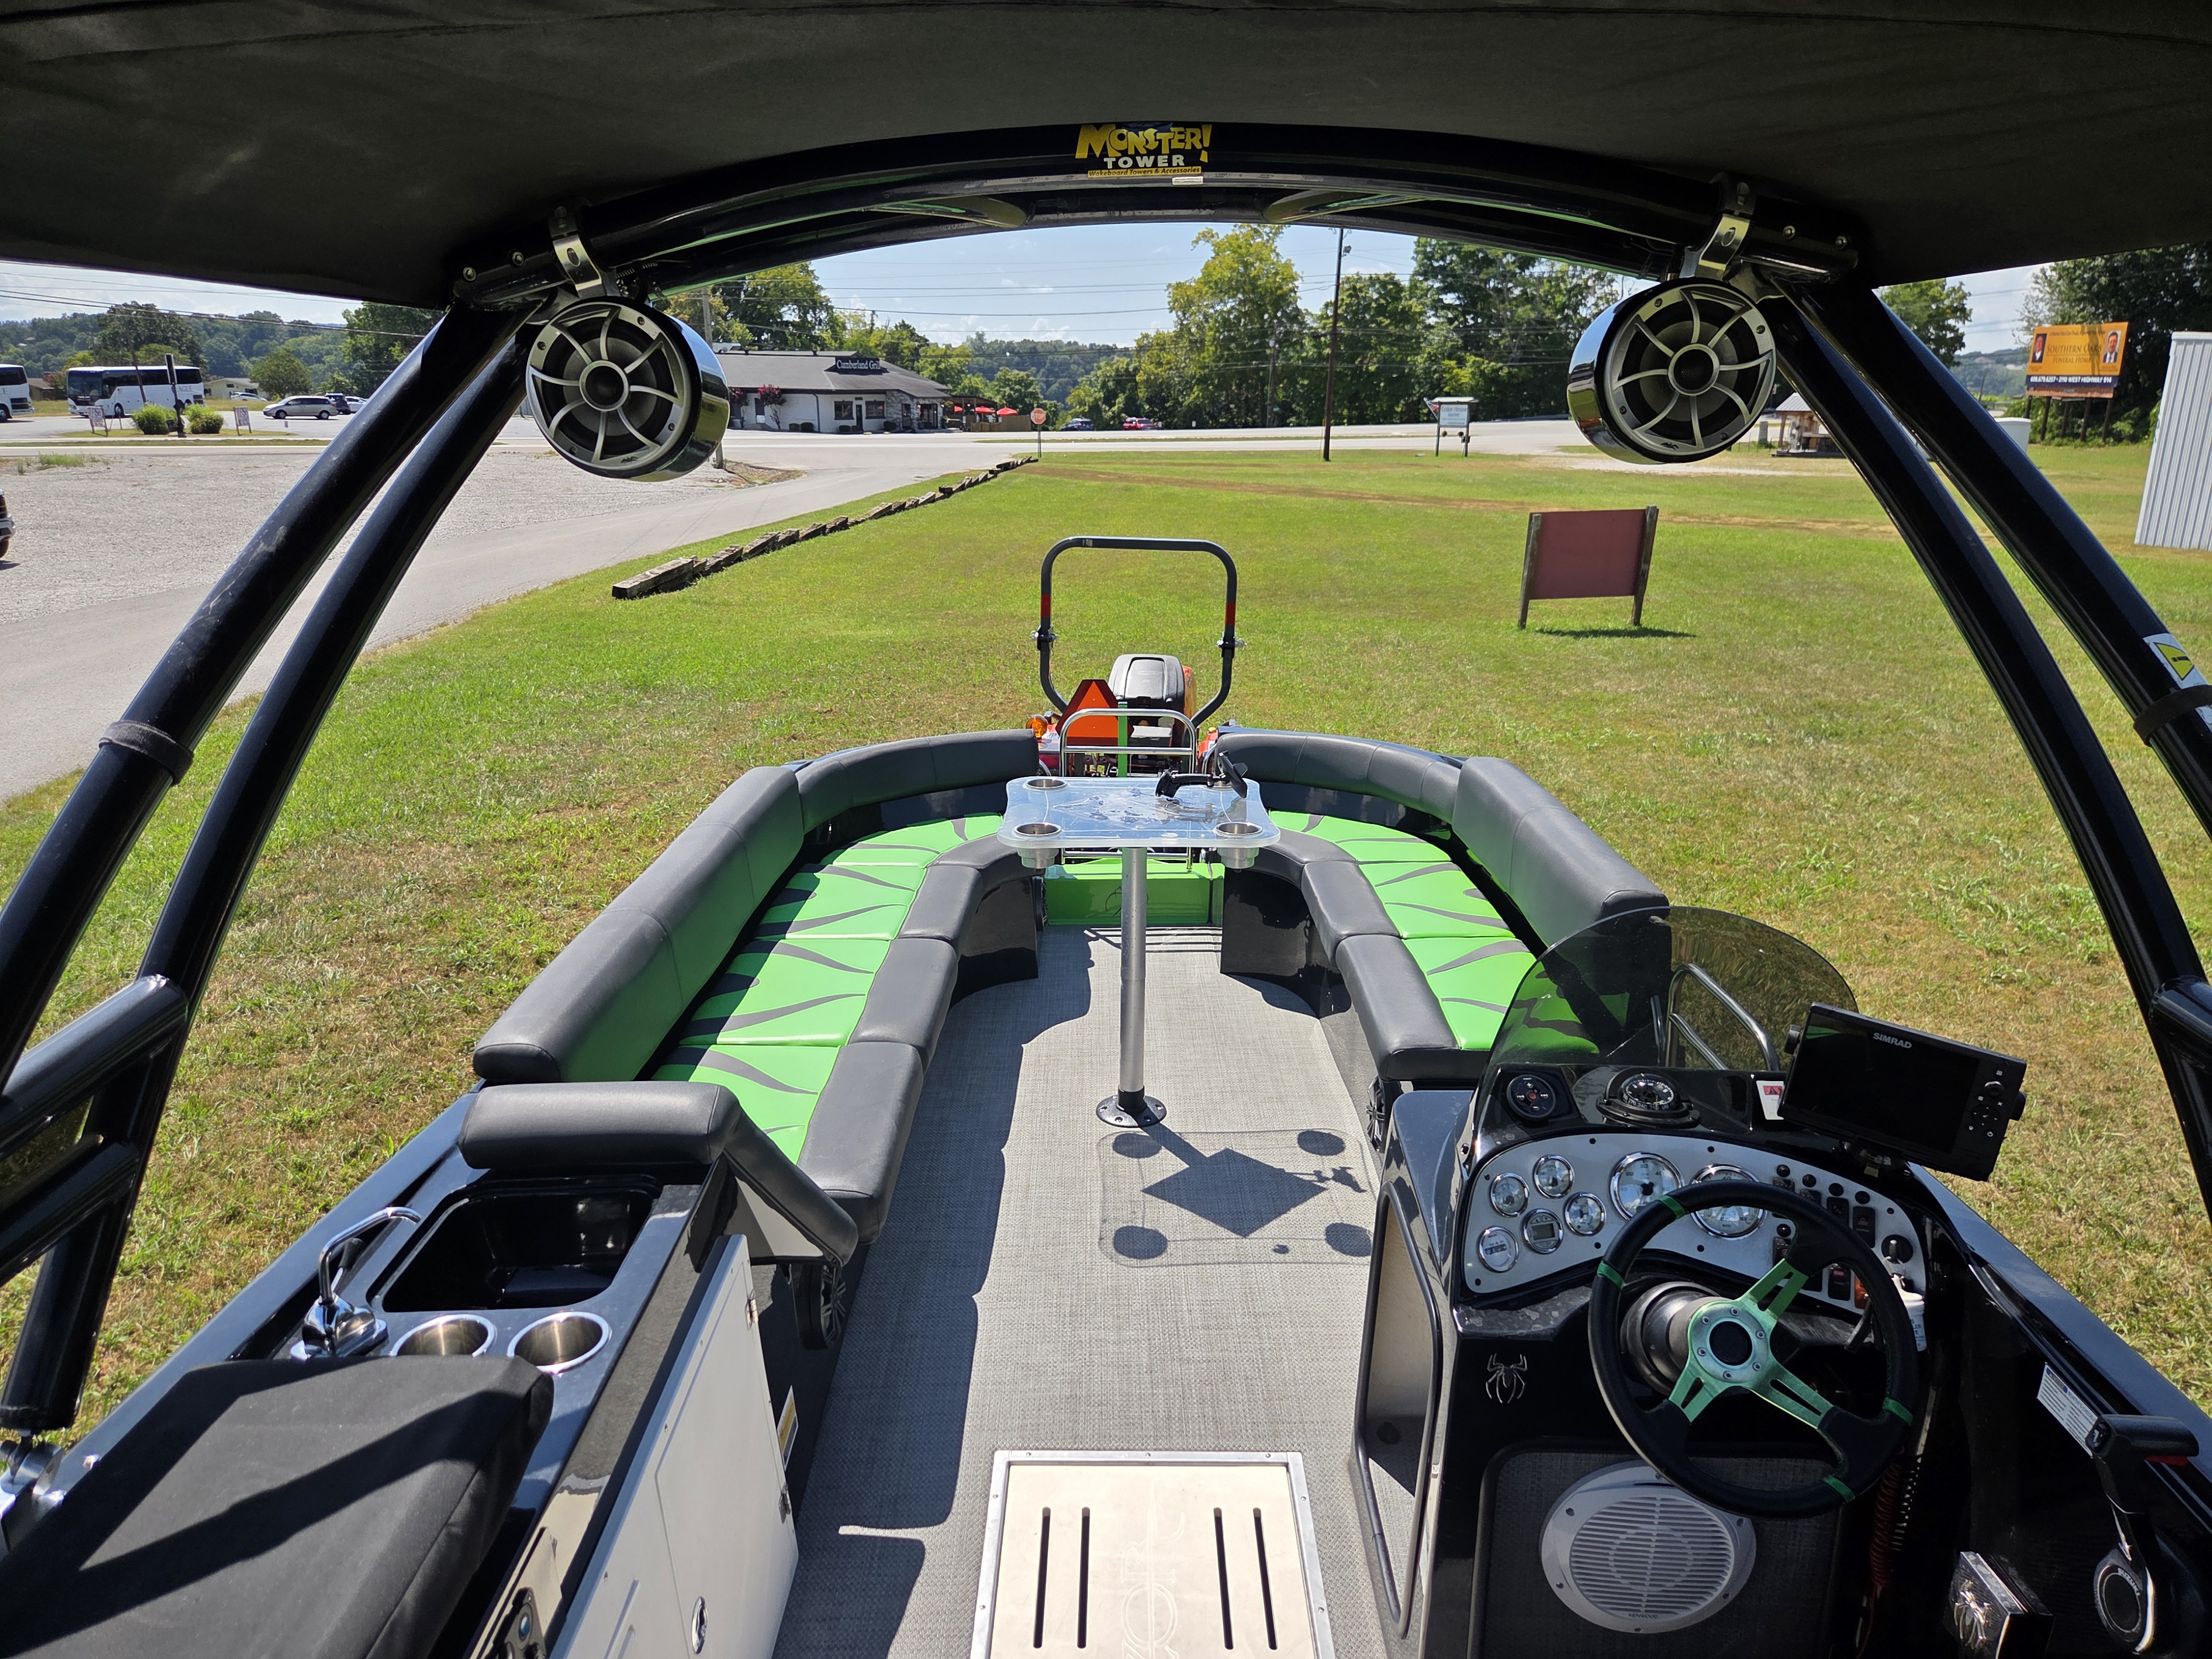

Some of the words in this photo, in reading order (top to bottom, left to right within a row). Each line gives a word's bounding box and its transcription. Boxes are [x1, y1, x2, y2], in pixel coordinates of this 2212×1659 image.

[1075, 124, 1212, 163] MONSTER!
[1103, 154, 1185, 169] TOWER
[2046, 344, 2082, 353] SOUTHERN
[837, 359, 868, 369] Cumberland
[869, 360, 881, 370] Grill
[1873, 1032, 1912, 1048] SIMRAD
[2117, 1567, 2141, 1596] SUZUKI
